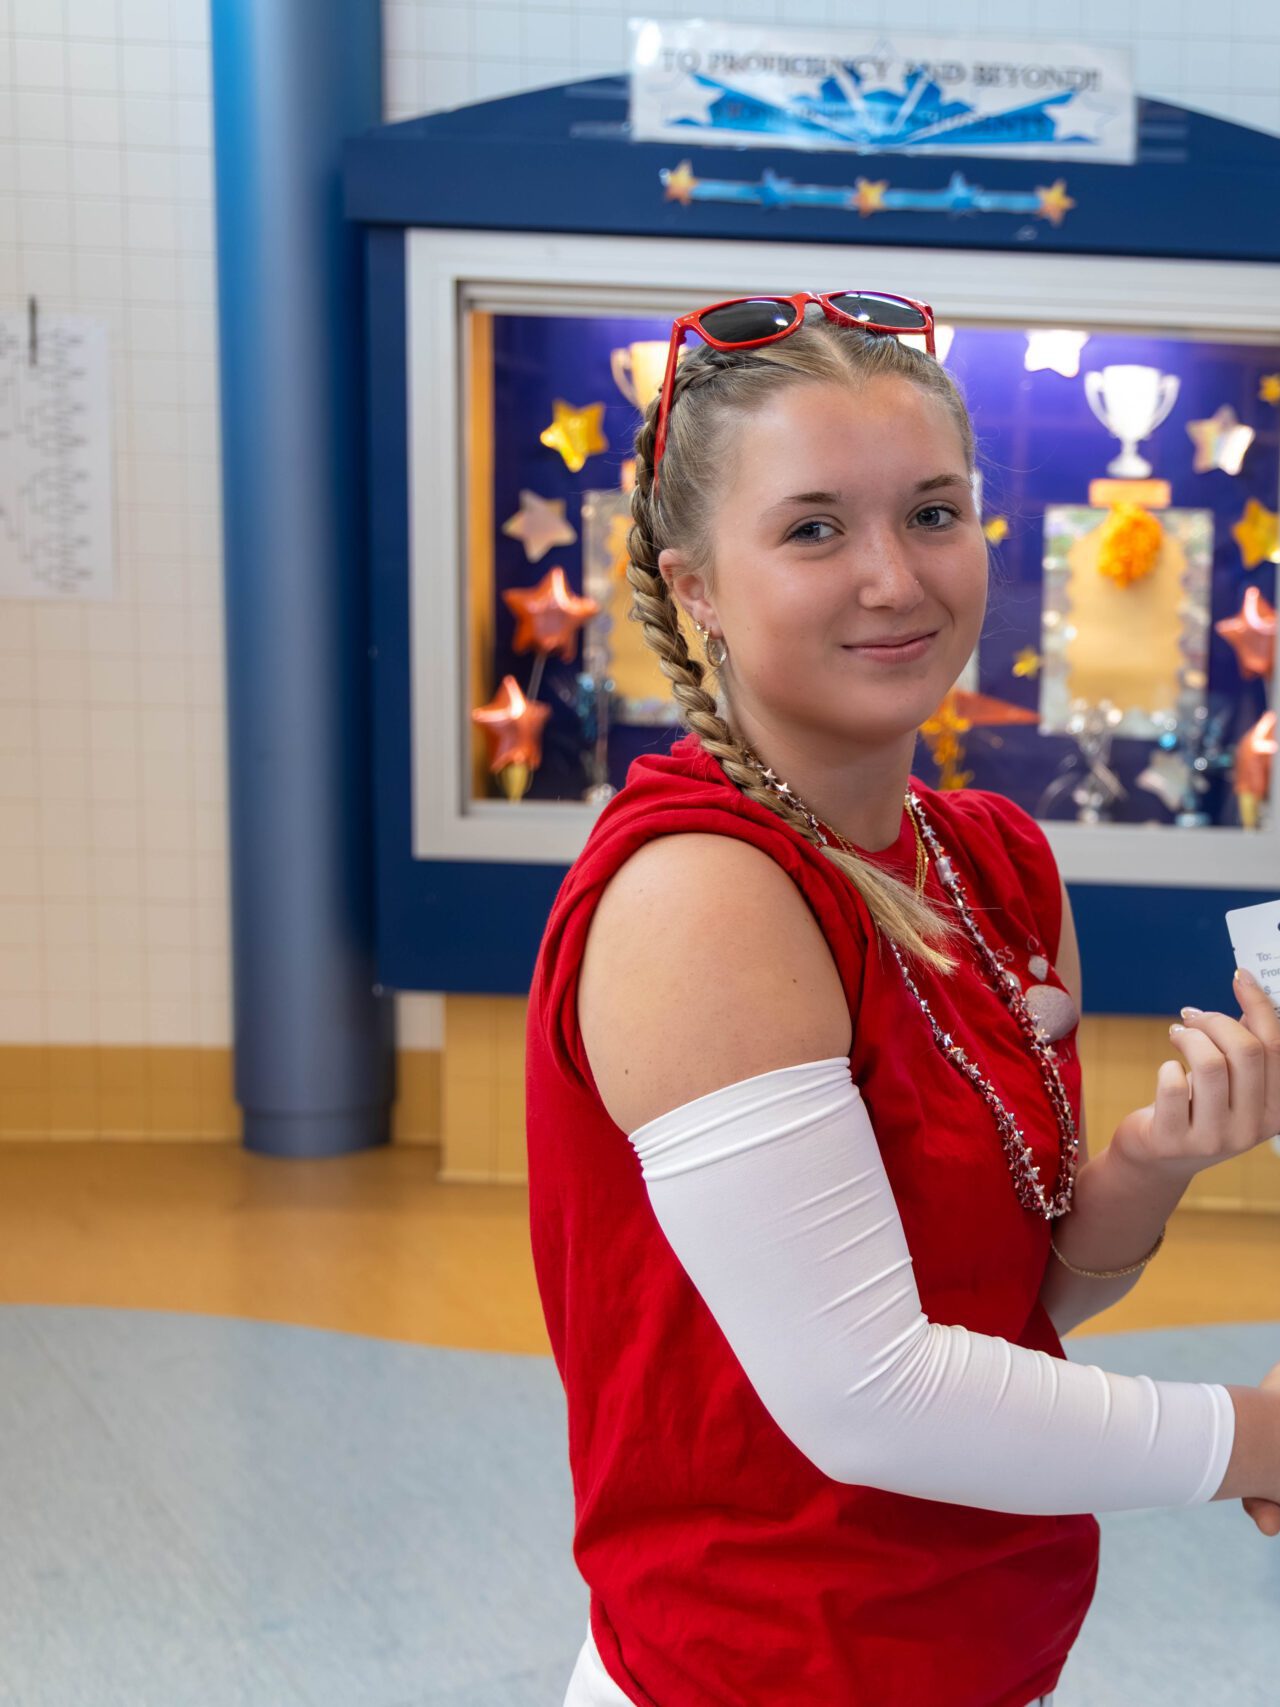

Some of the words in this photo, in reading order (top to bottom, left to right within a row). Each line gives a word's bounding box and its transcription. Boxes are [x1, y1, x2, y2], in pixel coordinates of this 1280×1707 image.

[662, 48, 698, 74] TO
[973, 64, 1104, 91] BEYOND!
[1256, 952, 1272, 962] To:
